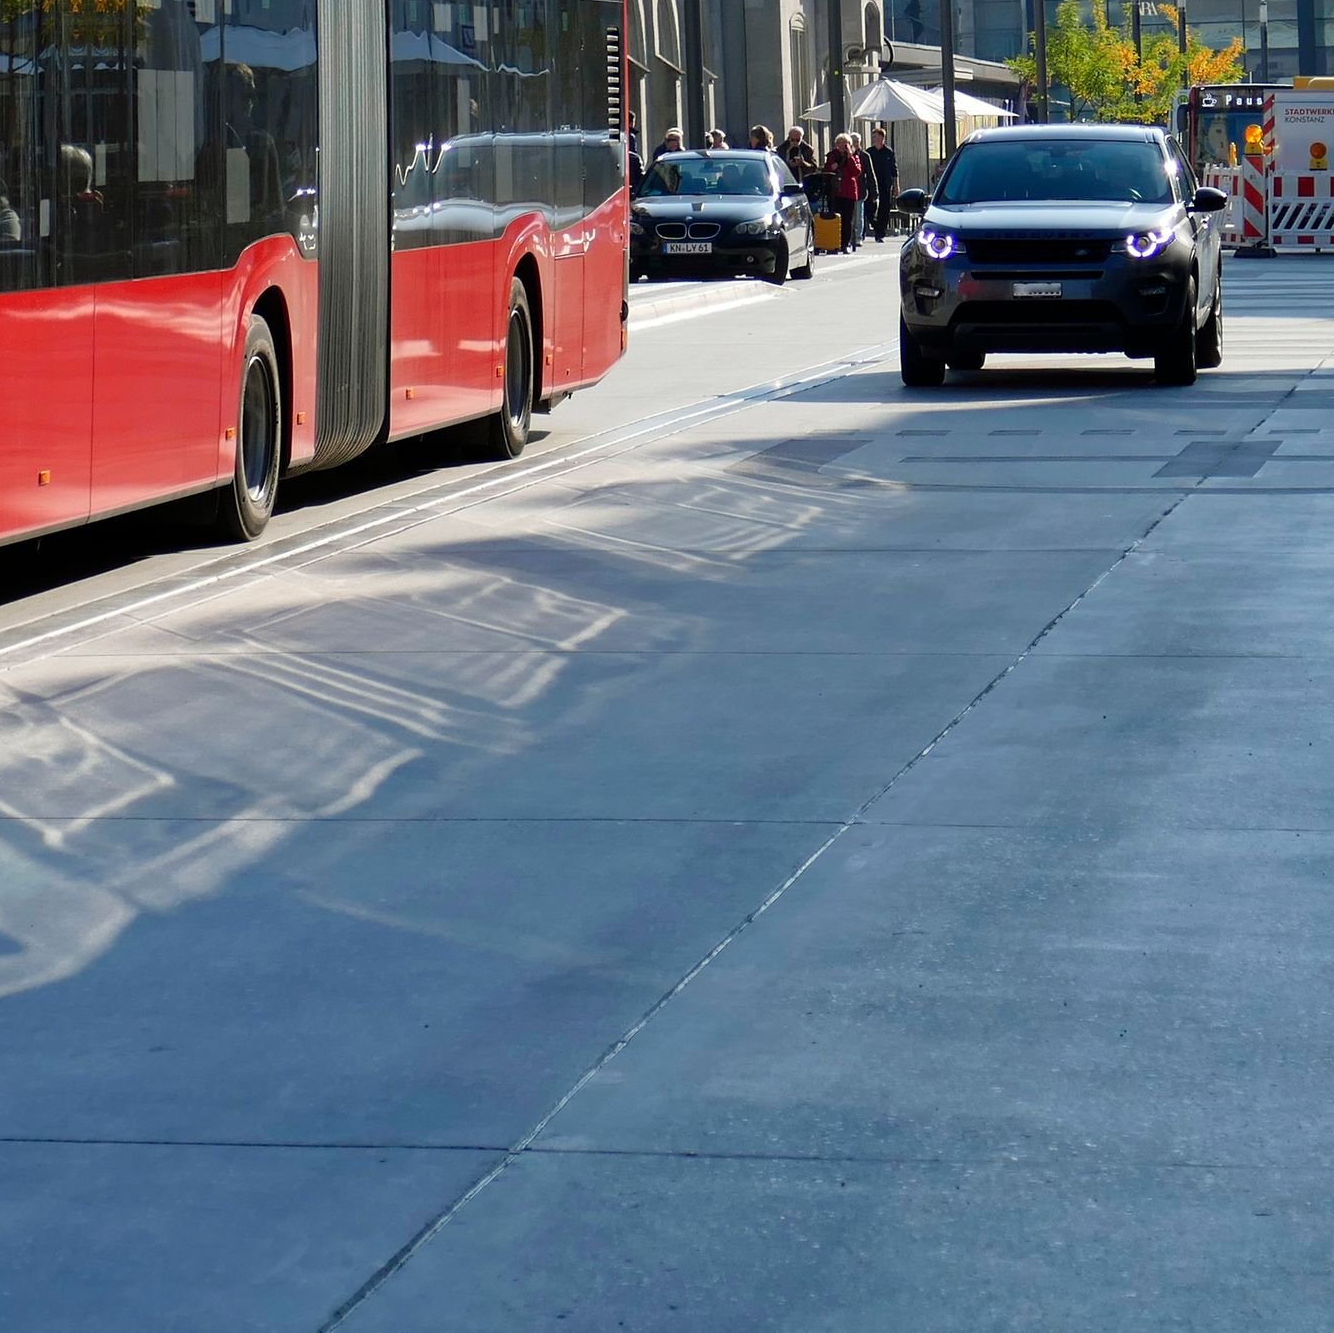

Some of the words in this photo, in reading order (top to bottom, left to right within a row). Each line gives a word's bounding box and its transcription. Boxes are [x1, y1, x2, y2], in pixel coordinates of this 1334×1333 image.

[1225, 94, 1263, 106] Paus
[686, 244, 697, 252] LY
[699, 244, 708, 252] 61
